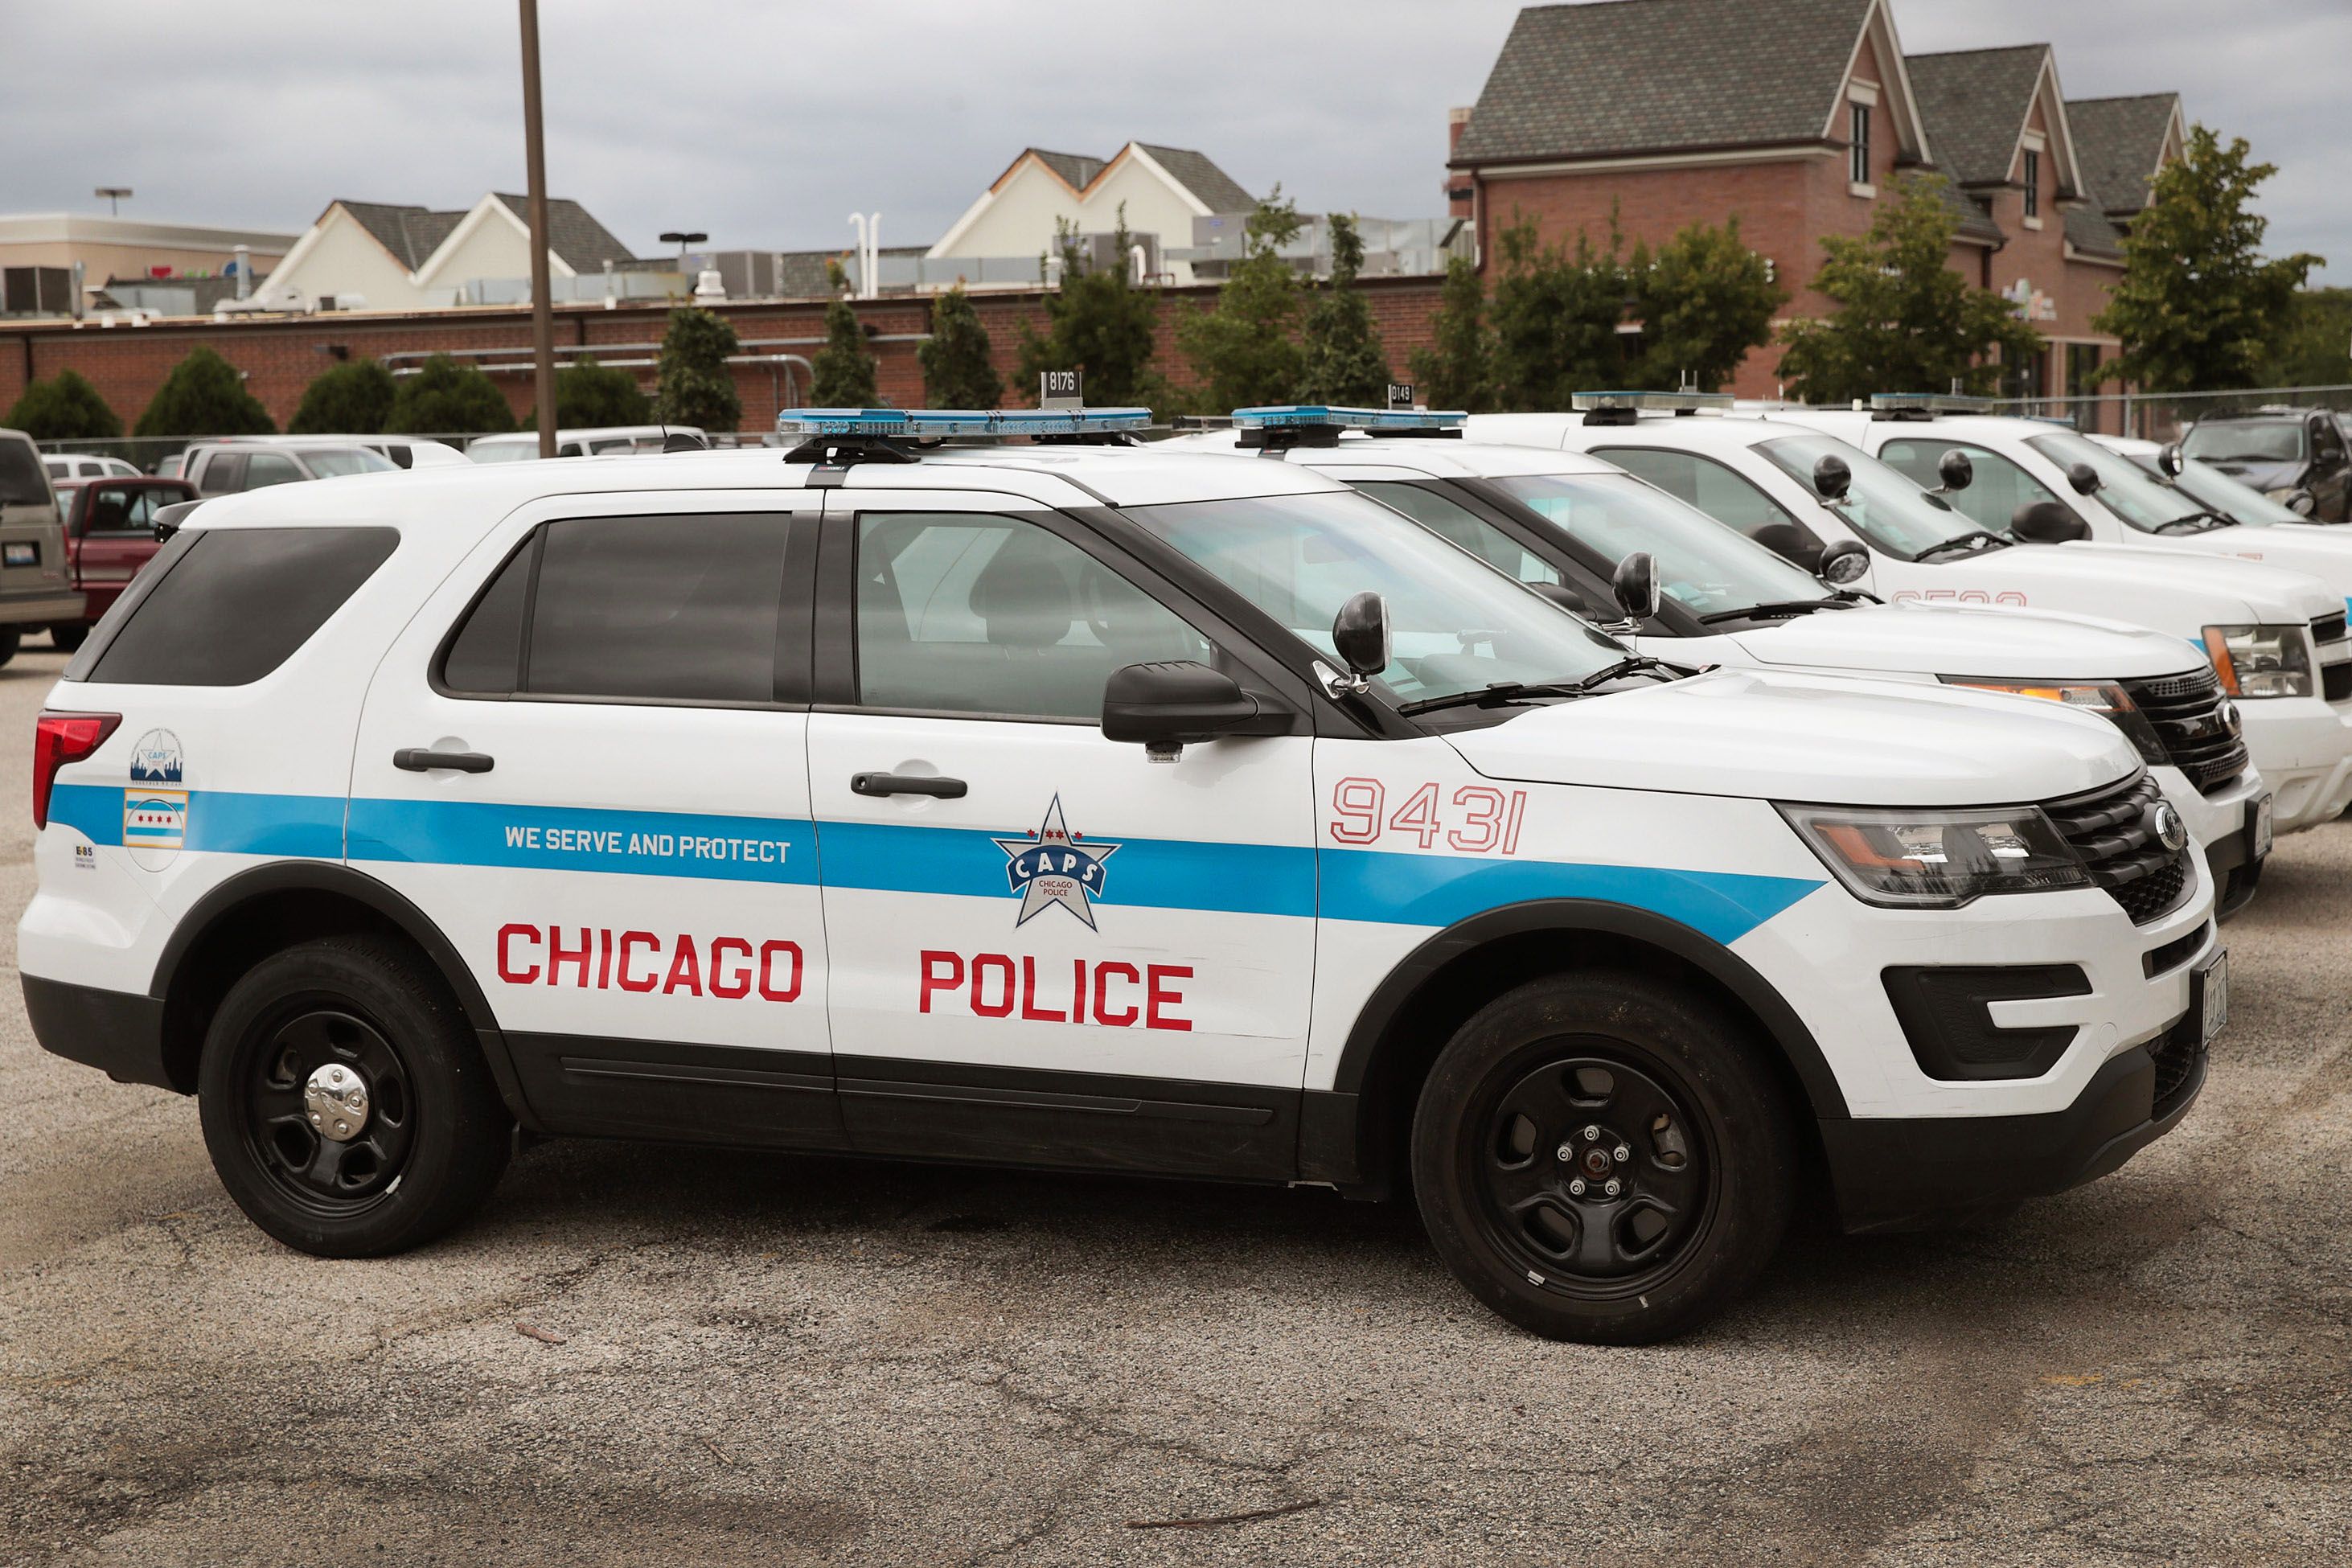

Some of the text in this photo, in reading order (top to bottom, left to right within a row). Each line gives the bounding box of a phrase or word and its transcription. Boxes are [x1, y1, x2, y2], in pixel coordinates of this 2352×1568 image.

[1050, 371, 1074, 391] 8176
[1392, 385, 1410, 400] 0149
[148, 751, 167, 760] CAPS
[1330, 777, 1527, 855] 9431
[505, 826, 790, 864] WE SERVE AND PROTECT
[1015, 852, 1098, 882] CAPS
[1039, 880, 1073, 889] CHICAGO
[1043, 889, 1069, 897] POLICE
[497, 923, 1194, 1032] CHICAGO POLICE
